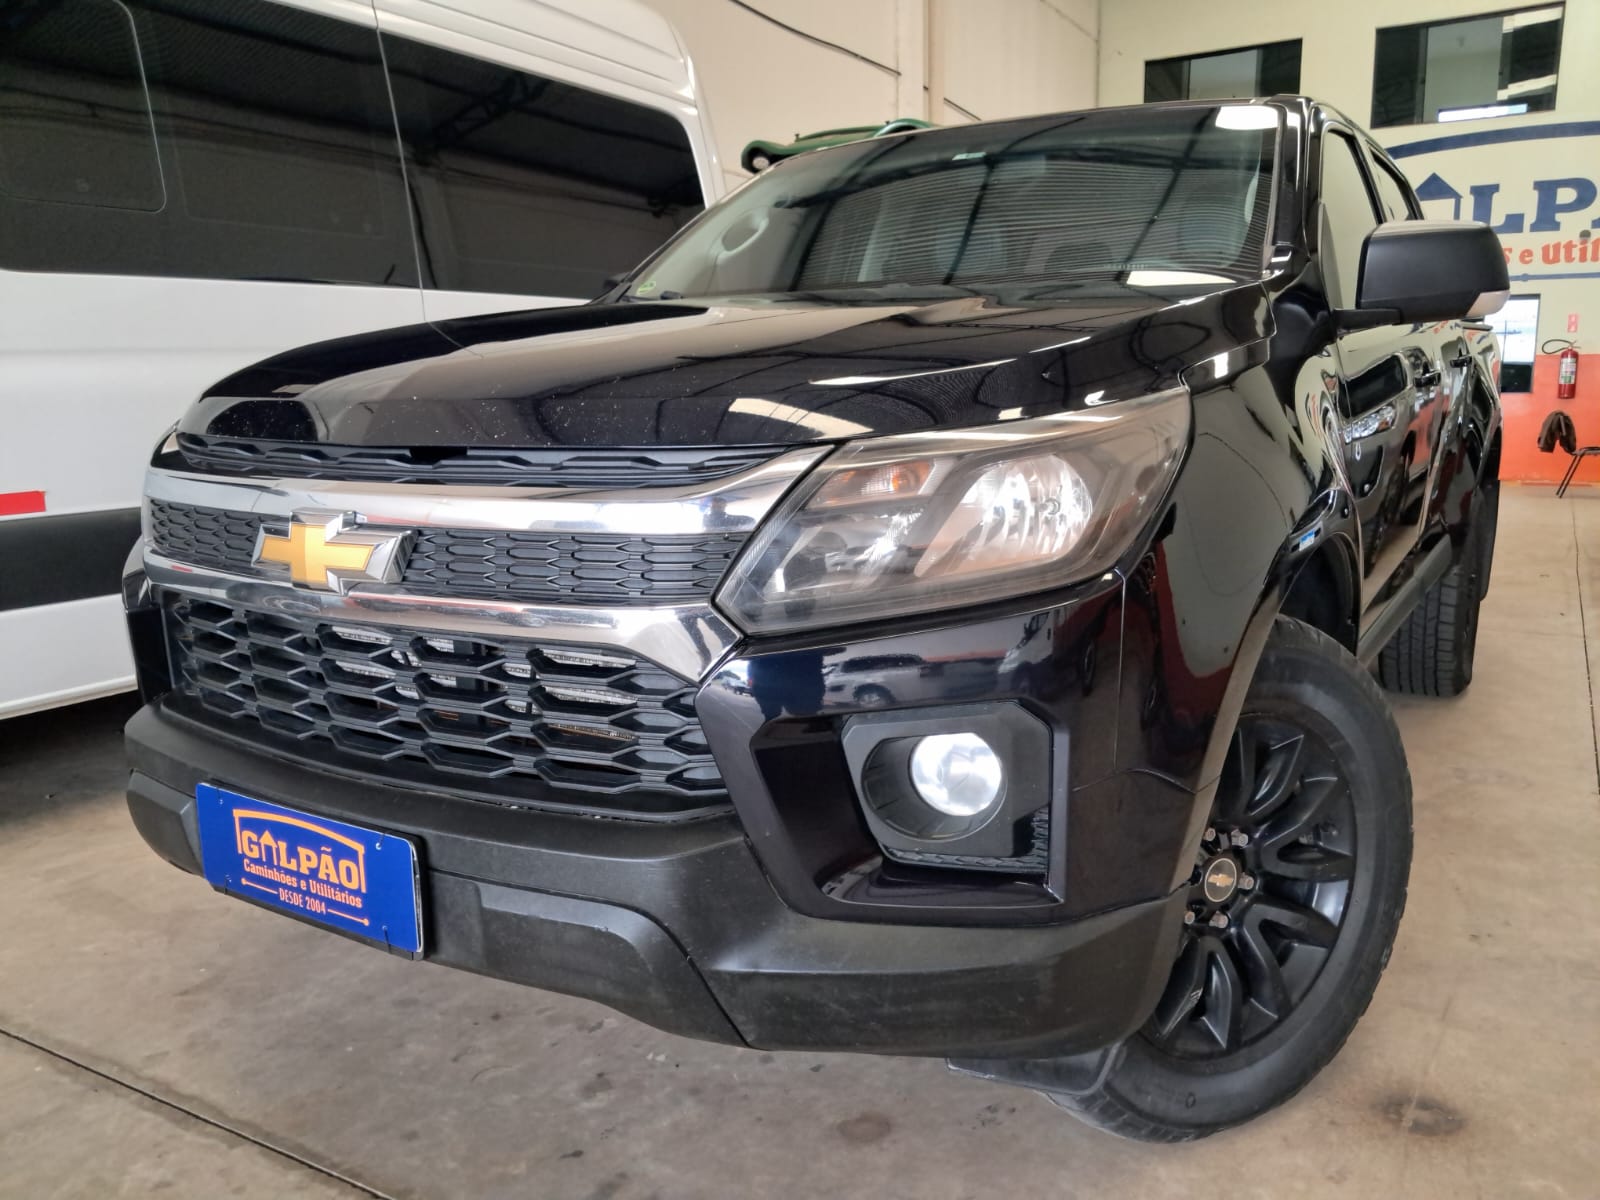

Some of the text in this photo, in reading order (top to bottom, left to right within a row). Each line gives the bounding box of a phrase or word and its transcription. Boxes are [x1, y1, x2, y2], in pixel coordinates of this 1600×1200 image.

[1519, 248, 1534, 265] e
[241, 829, 360, 890] GALPÃO
[279, 887, 327, 914] DESDE 2004
[300, 879, 307, 891] e
[309, 880, 362, 908] Utilitários
